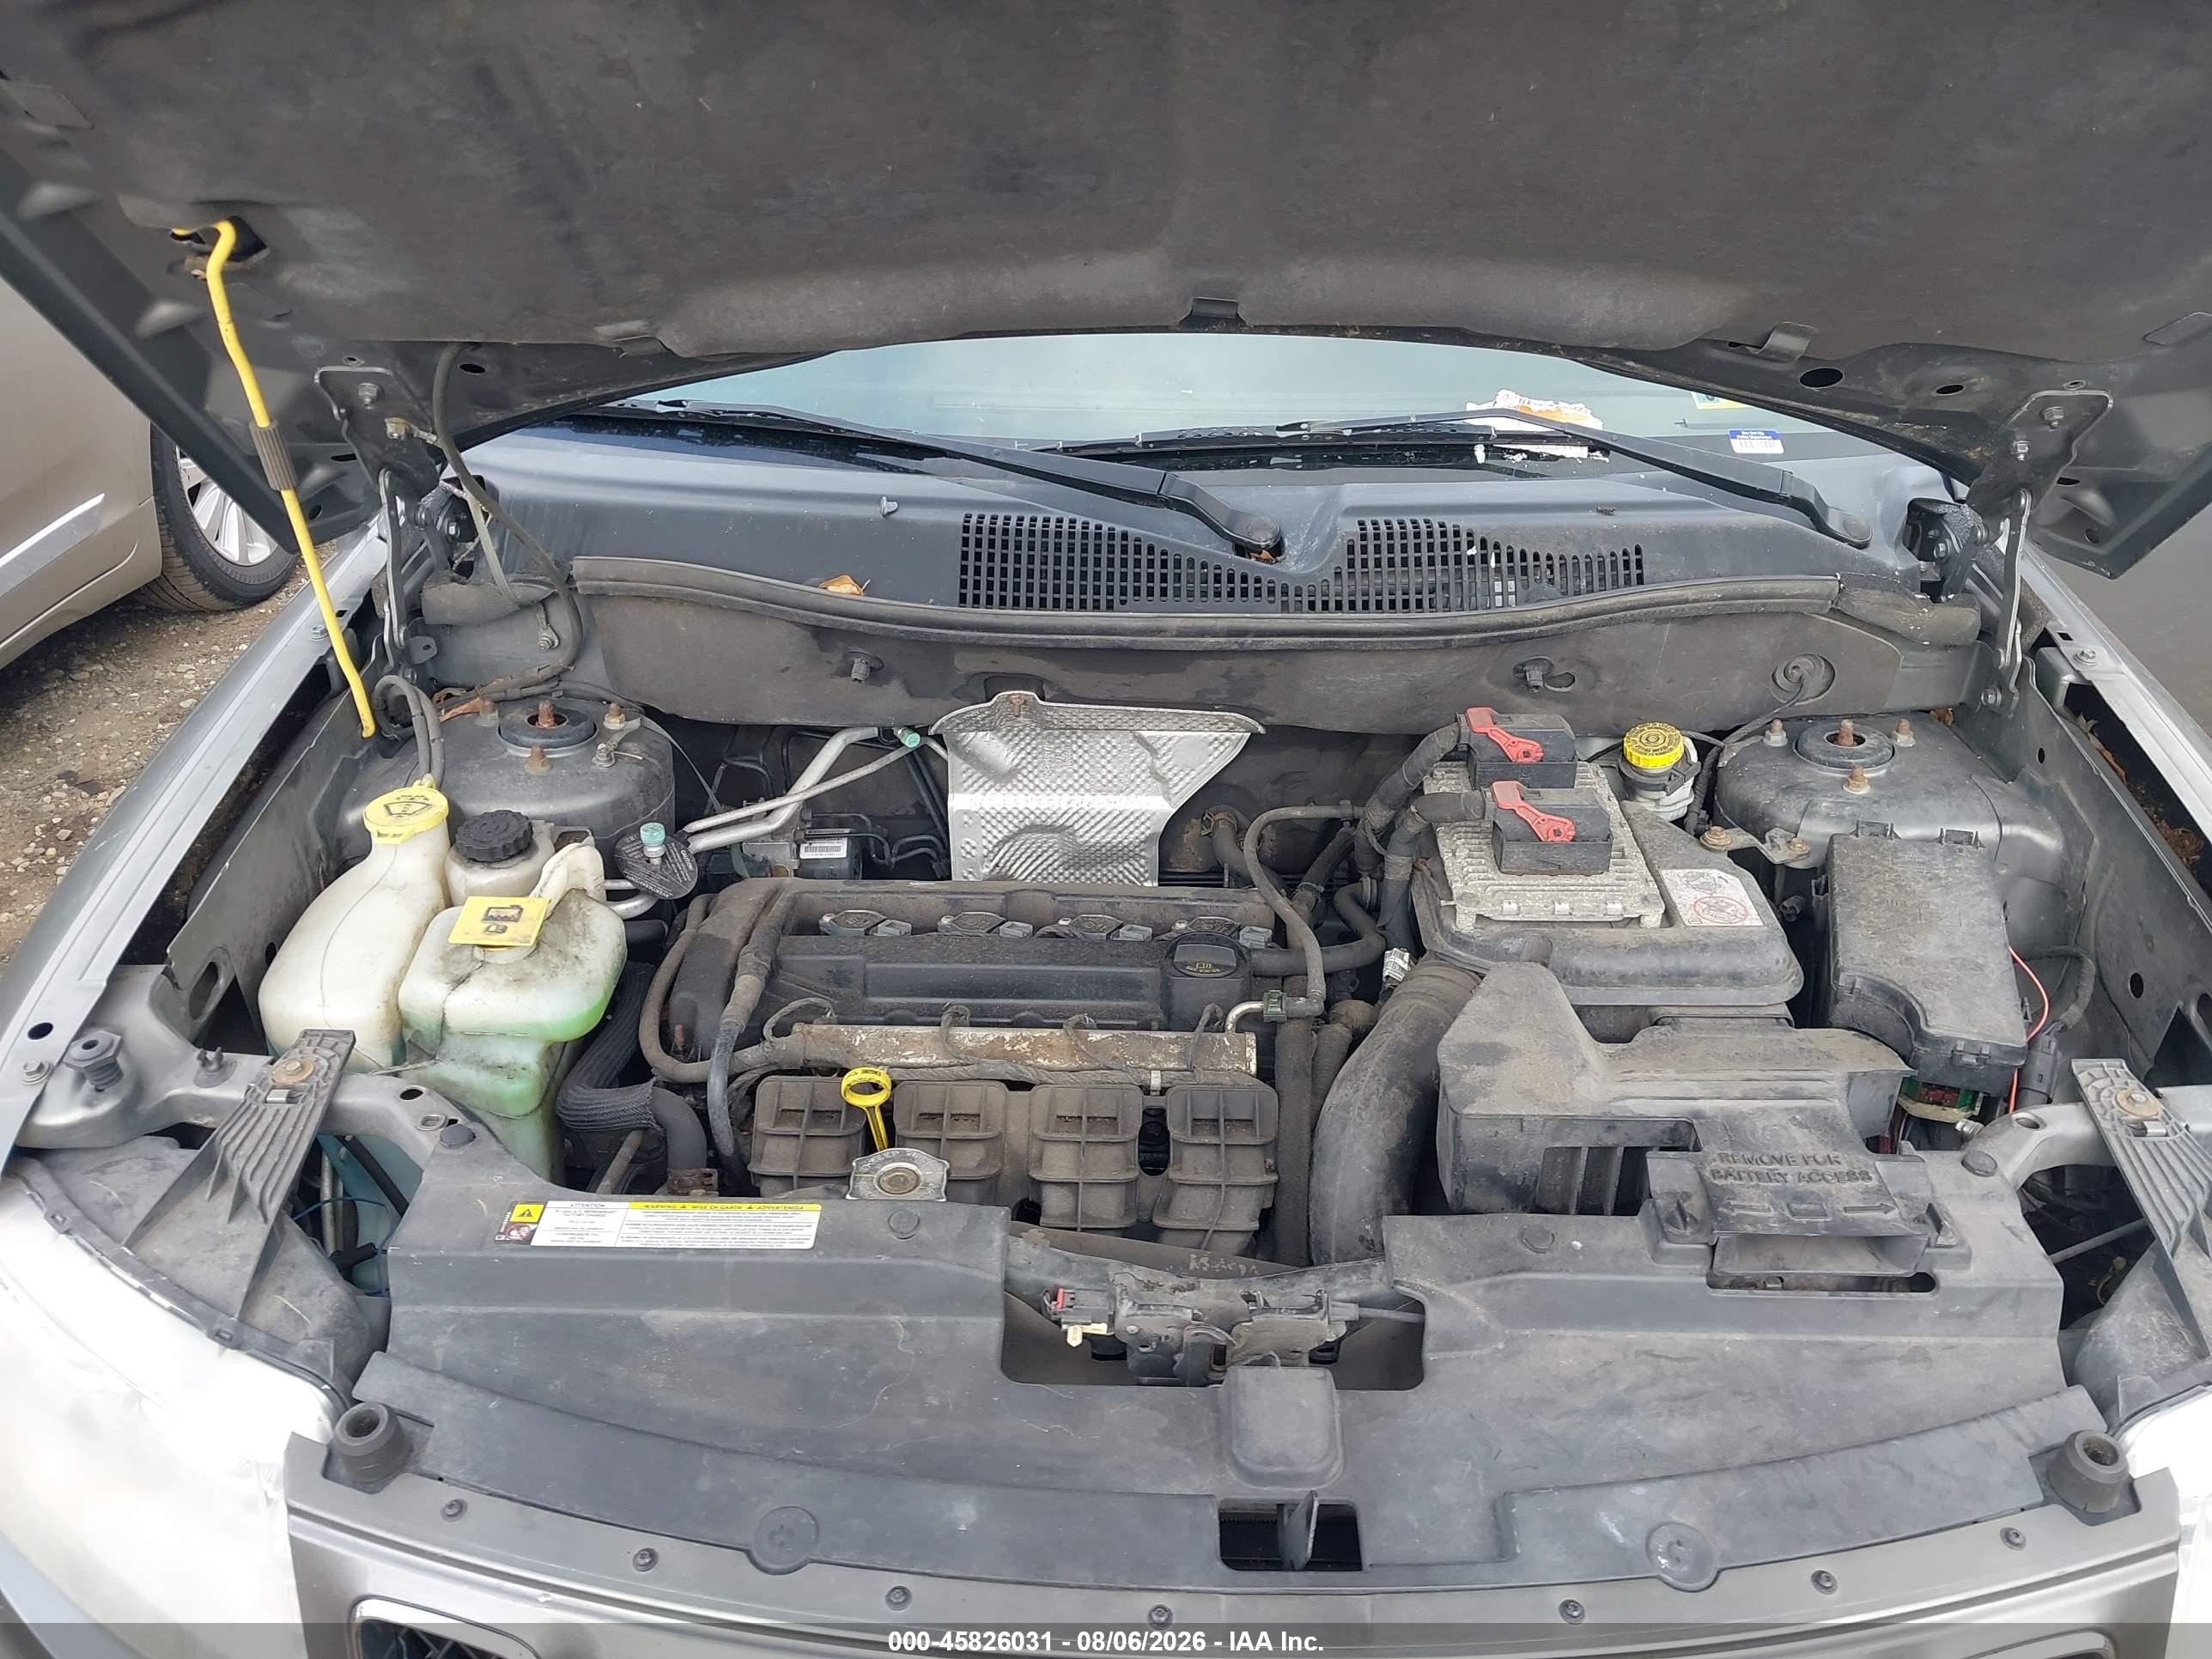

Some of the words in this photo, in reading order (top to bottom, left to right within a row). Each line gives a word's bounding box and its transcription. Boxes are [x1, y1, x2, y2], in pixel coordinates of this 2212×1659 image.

[1717, 1152, 1797, 1166] REMOVE
[1802, 1153, 1841, 1166] FOR
[1710, 1169, 1789, 1183] BATTERY
[1797, 1170, 1874, 1183] ACCESS
